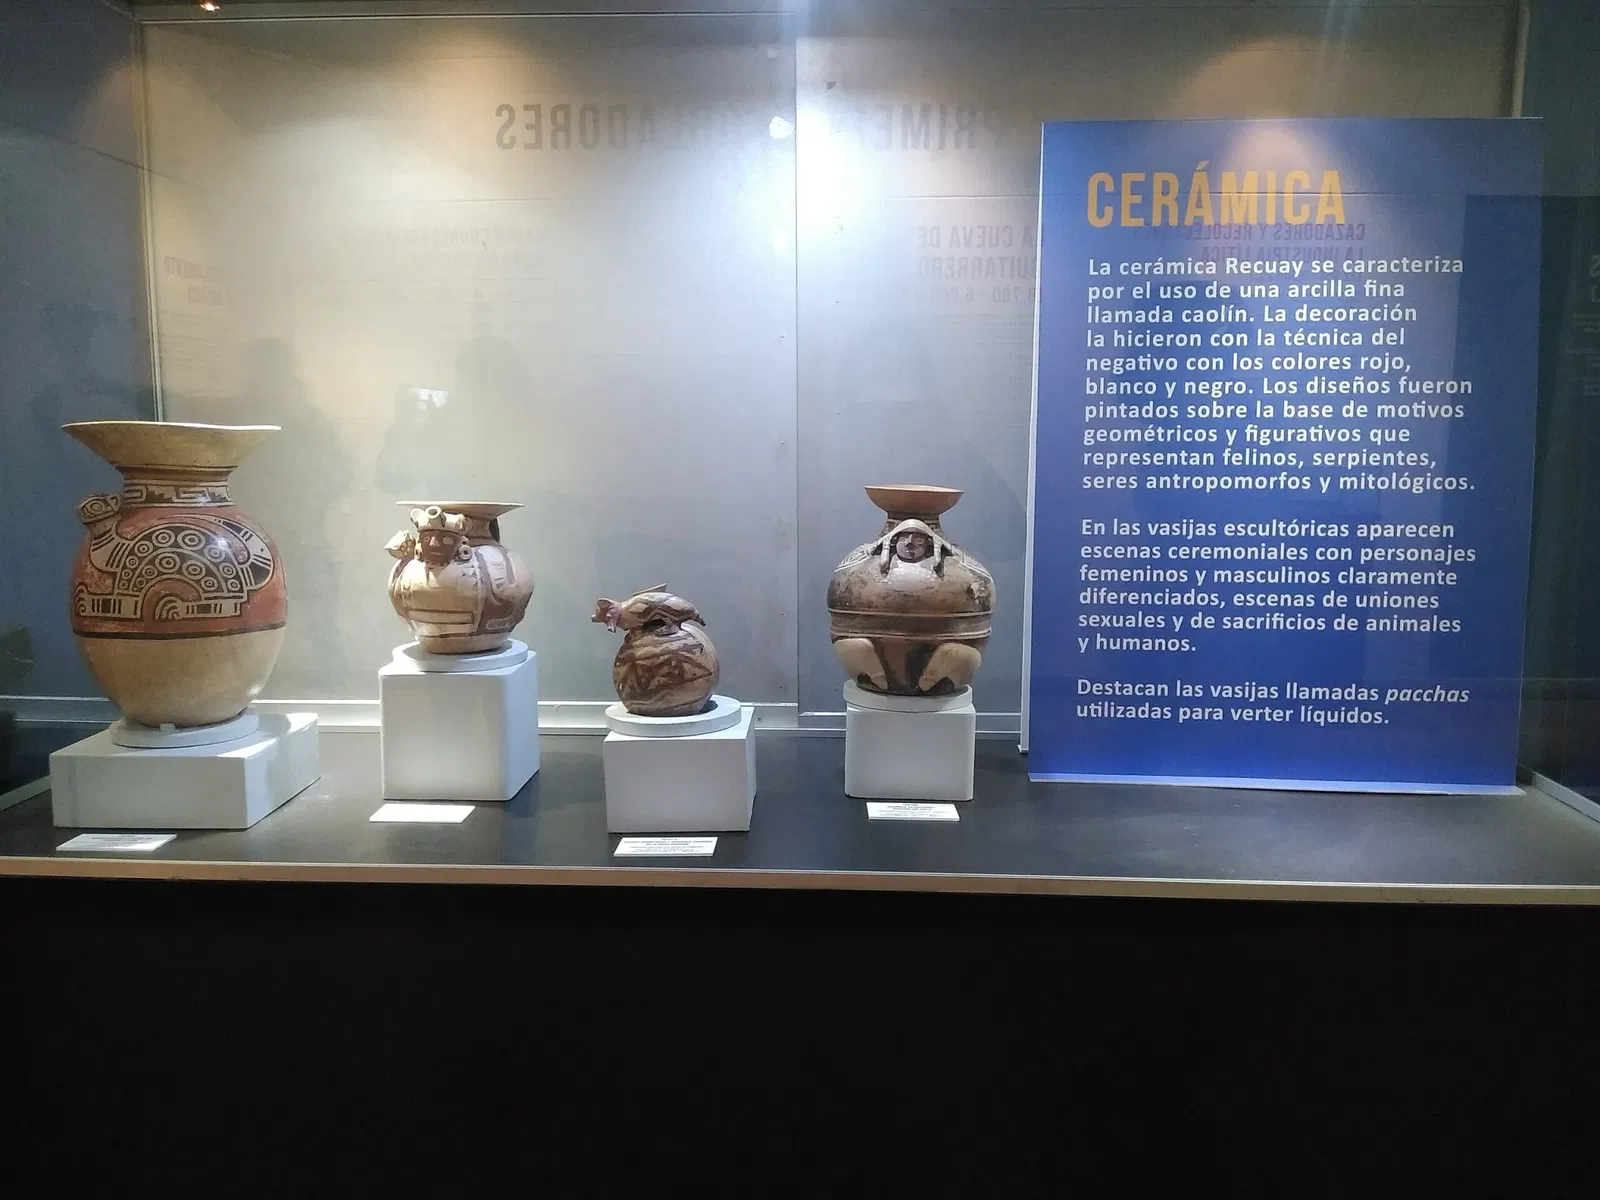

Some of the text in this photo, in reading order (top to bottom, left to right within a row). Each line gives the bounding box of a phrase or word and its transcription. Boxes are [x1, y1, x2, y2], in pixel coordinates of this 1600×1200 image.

[1087, 160, 1346, 228] CERÁMICA
[1089, 255, 1464, 278] La cerámica Recuay se caracteriza
[1088, 279, 1405, 304] por el uso de una arcilla fina
[1087, 302, 1417, 324] llamada caolín. La decoración
[1087, 327, 1405, 348] la hicieron con la técnica del
[1086, 351, 1411, 375] negativo con los colores rojo,
[1085, 375, 1472, 399] blanco y negro. Los diseños fueron
[1085, 399, 1465, 423] pintados sobre la base de motivos
[1083, 423, 1411, 446] geométricos y figurativos que
[1083, 447, 1436, 470] representan felinos, serpientes,
[1082, 471, 1475, 494] seres antropomorfos y mitológicos.
[1081, 517, 1455, 542] En las vasijas escultóricas aparecen
[1080, 542, 1476, 566] escenas ceremoniales con personajes
[1079, 563, 1458, 587] femeninos y masculinos claramente
[1079, 587, 1439, 609] diferenciados, escenas de uniones
[1078, 610, 1462, 633] sexuales y de sacrificios de animales
[1077, 632, 1197, 654] y humanos.
[1077, 678, 1470, 706] Destacan las vasijas llamadas pacchas
[1076, 700, 1390, 727] utilizadas para verter líquidos.
